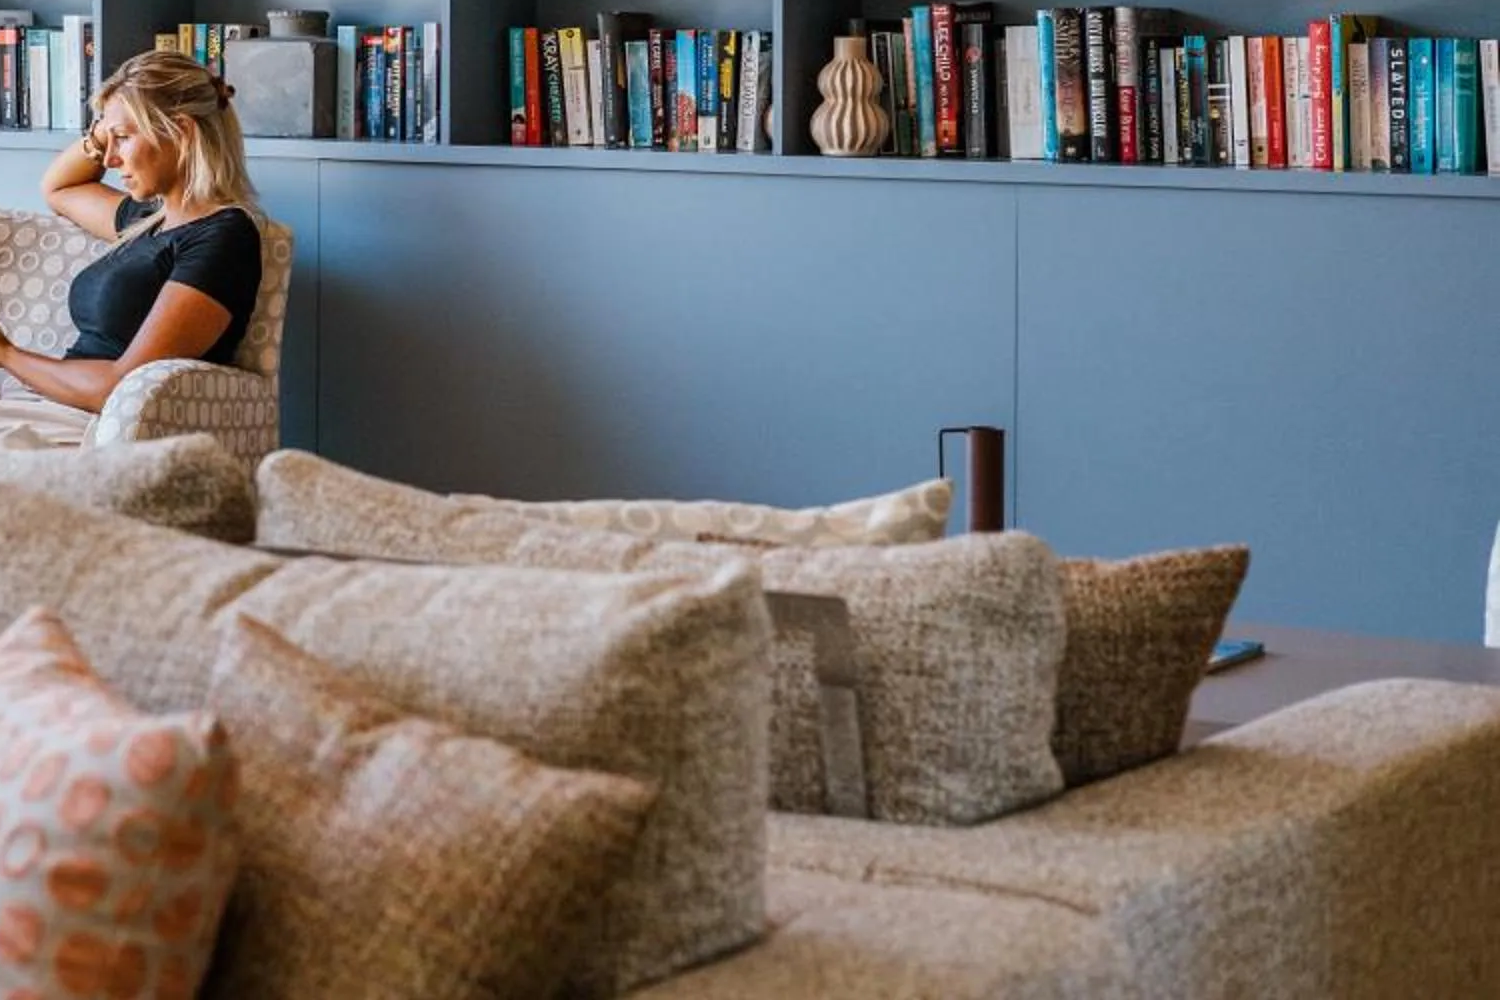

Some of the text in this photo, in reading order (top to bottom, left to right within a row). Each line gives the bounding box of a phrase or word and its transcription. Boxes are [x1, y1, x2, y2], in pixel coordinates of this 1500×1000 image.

[937, 21, 949, 43] LEE
[542, 34, 561, 123] KRAY CHEATED
[939, 44, 951, 81] CHILD
[1390, 47, 1405, 119] SLATED
